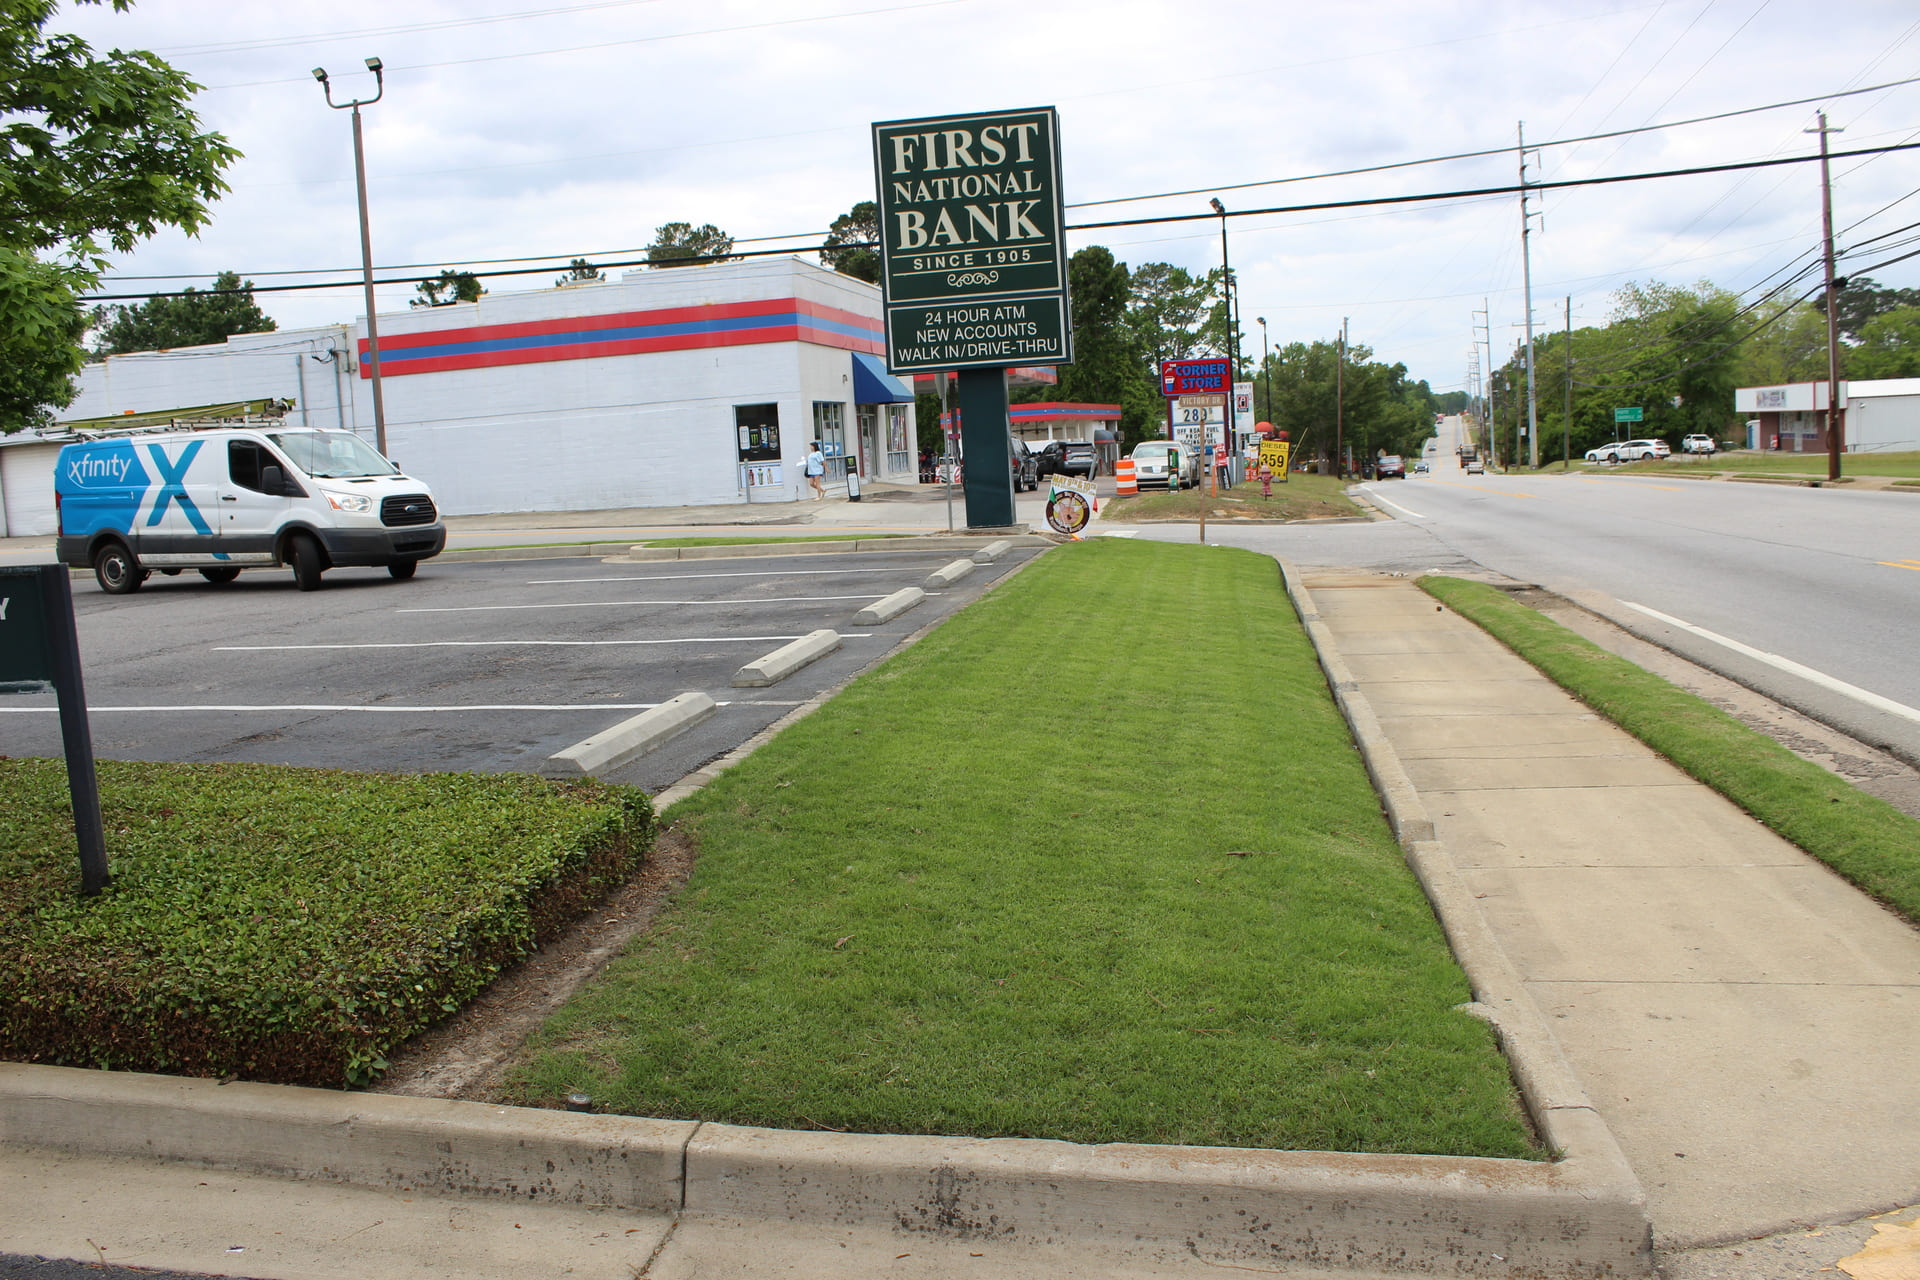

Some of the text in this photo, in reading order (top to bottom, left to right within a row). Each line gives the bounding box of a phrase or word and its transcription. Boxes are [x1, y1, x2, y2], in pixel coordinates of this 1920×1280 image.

[890, 122, 1039, 174] FIRST
[893, 170, 1042, 204] NATIONAL
[895, 199, 1046, 250] BANK
[913, 249, 1031, 270] SINCE 1905
[925, 305, 1025, 326] 24 HOUR ATM
[916, 322, 1038, 344] NEW ACCOUNTS
[899, 347, 941, 362] WALK
[1175, 363, 1227, 376] CORNER
[1181, 376, 1222, 389] STORE
[1182, 396, 1210, 405] VICTORY
[70, 453, 132, 484] xfinity
[1260, 453, 1285, 468] 359
